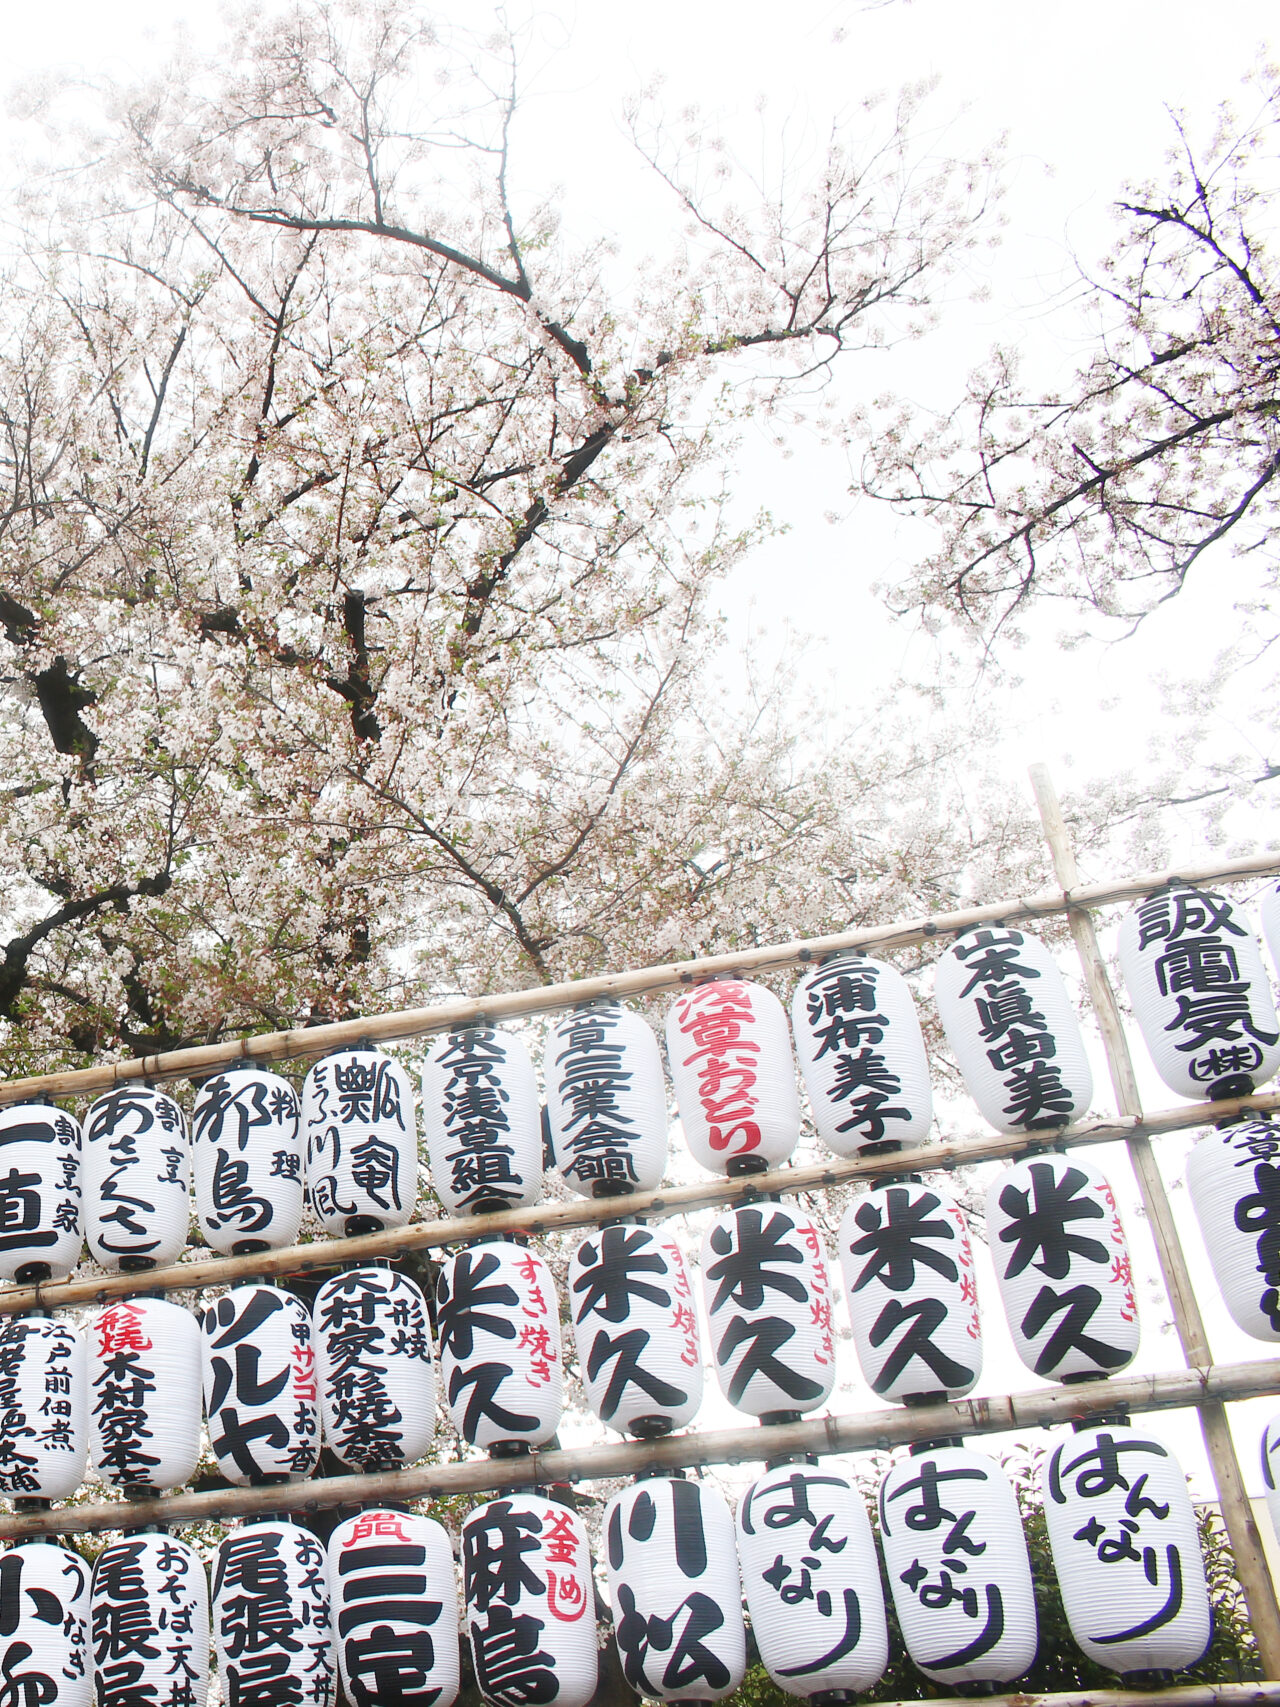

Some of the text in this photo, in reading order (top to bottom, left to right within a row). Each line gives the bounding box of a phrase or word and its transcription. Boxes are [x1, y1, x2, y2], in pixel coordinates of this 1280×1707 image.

[675, 979, 761, 1154] 浅草おどり
[805, 961, 912, 1140] 三浦布美子
[952, 930, 1074, 1126] 山本眞由美
[154, 1097, 187, 1193] 割烹
[268, 1085, 303, 1187] 料理
[386, 1273, 431, 1364] 人形焼
[436, 1253, 541, 1444] 米久
[511, 1254, 558, 1388] すき焼き
[573, 1227, 688, 1421] 米久
[706, 1209, 824, 1406] 米久
[851, 1188, 974, 1393] 米久
[999, 1162, 1133, 1376] 米久
[204, 1290, 291, 1476] ツルヤ
[62, 1554, 87, 1680] うなぎ
[212, 1532, 303, 1707] 尾張屋
[742, 1473, 861, 1677] はんなり
[879, 1461, 1004, 1671] はんなり
[1049, 1434, 1183, 1644] はんなり
